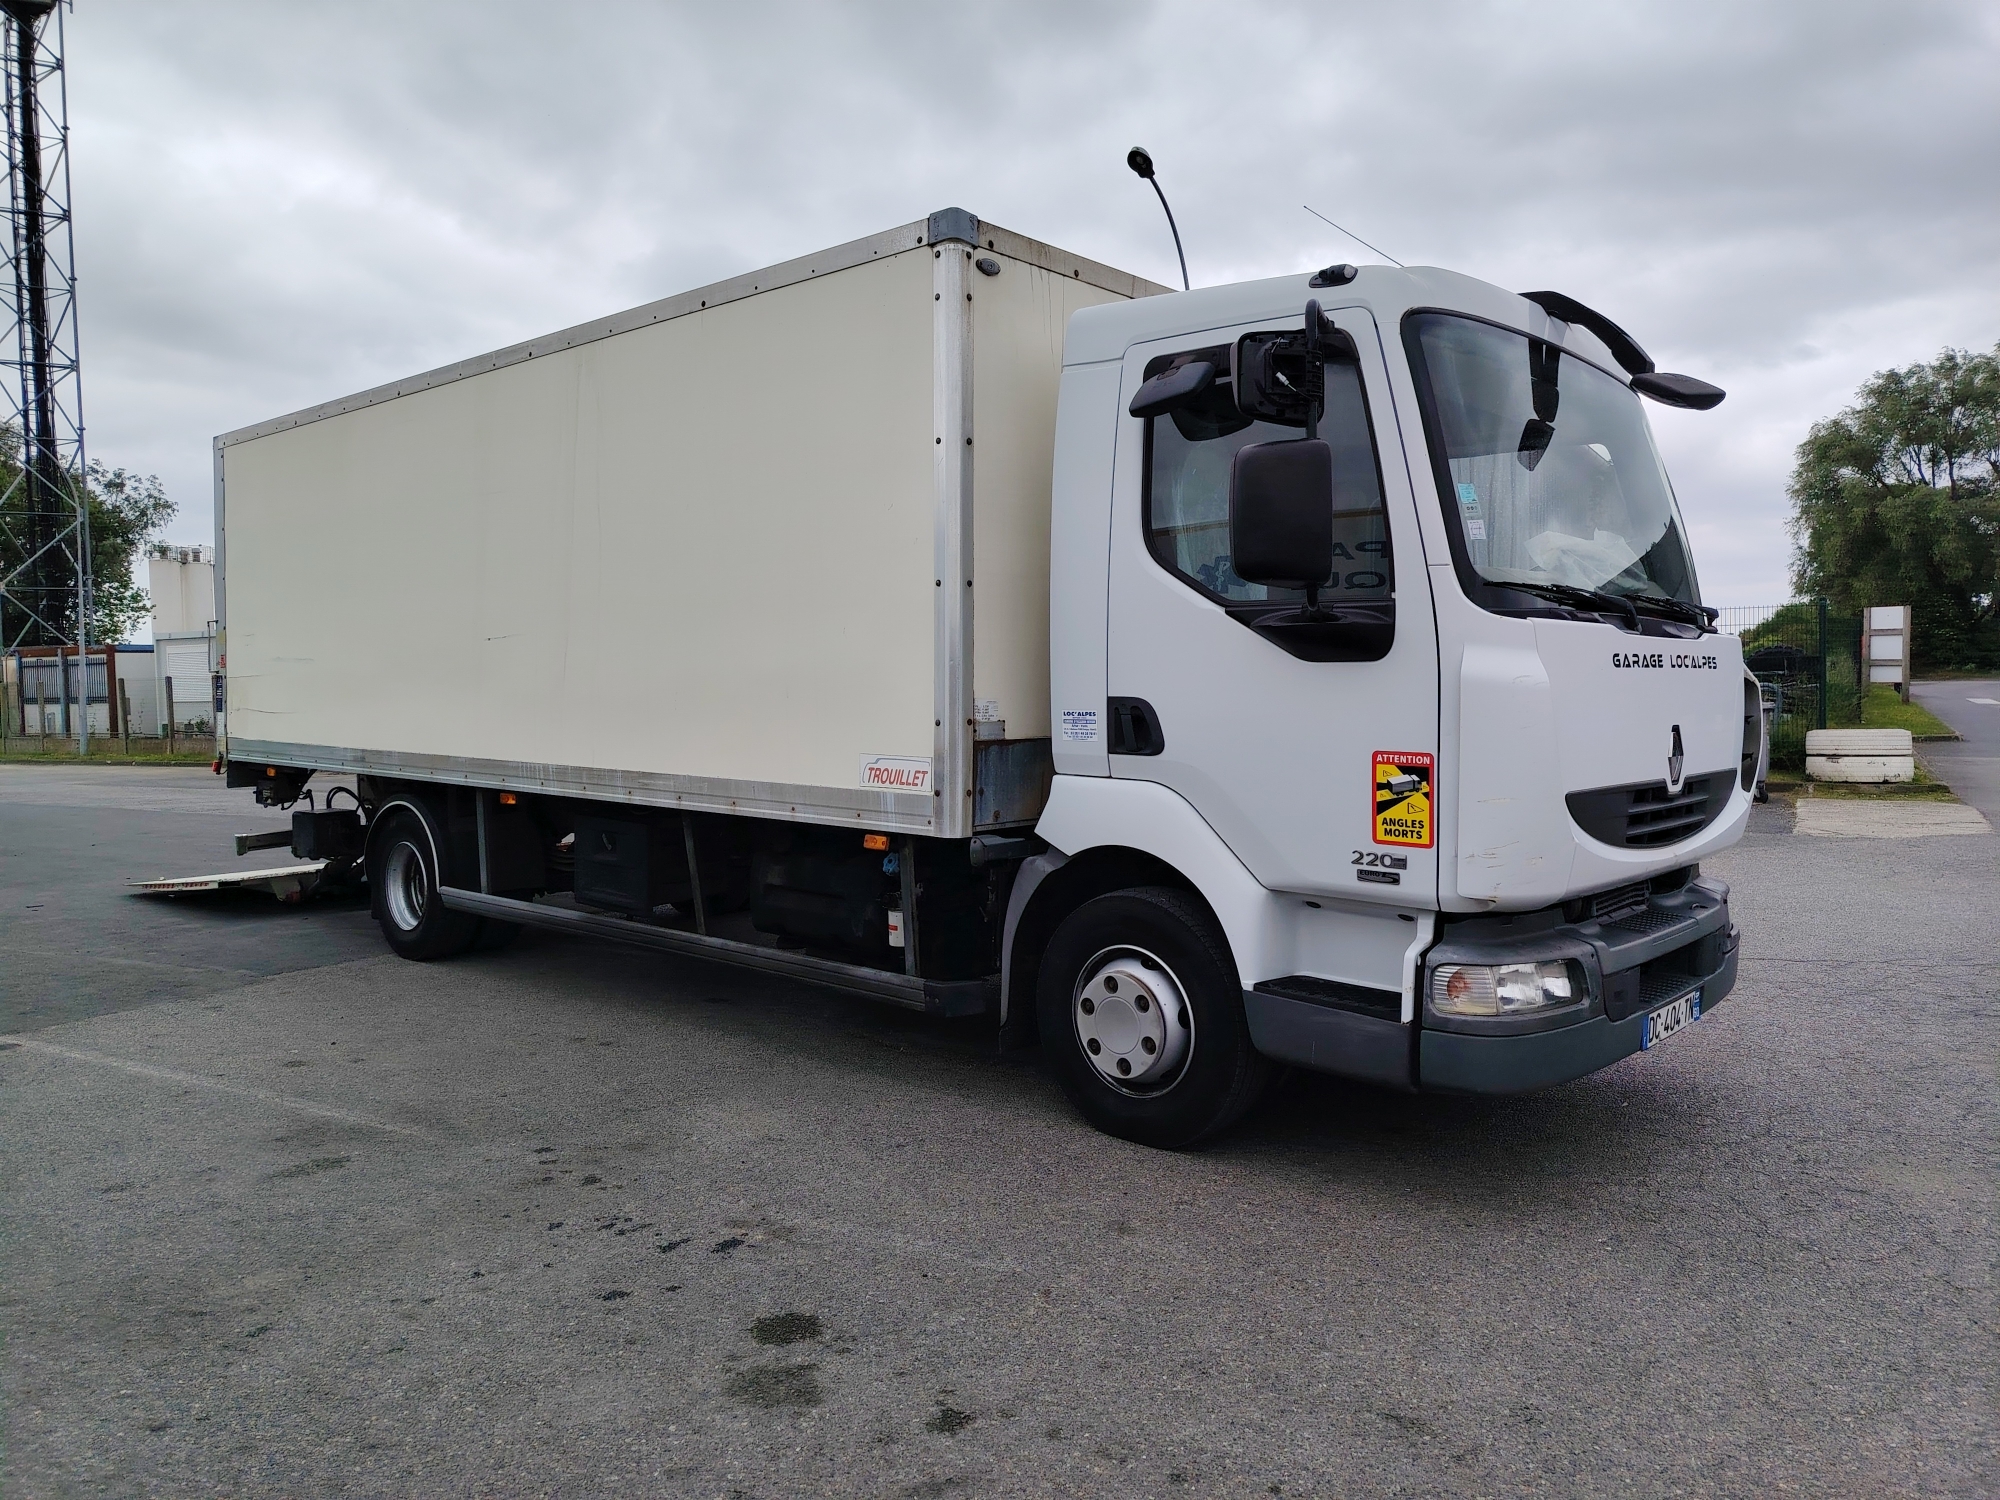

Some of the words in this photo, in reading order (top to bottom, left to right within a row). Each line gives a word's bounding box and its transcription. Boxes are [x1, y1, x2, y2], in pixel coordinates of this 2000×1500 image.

[1612, 653, 1664, 668] GARAGE
[1670, 654, 1717, 669] LOC'ALPES
[1376, 754, 1431, 765] ATTENTION
[868, 767, 928, 787] TROUILLET
[1381, 817, 1425, 829] ANGLES
[1384, 828, 1422, 839] MORTS
[1351, 850, 1393, 868] 220
